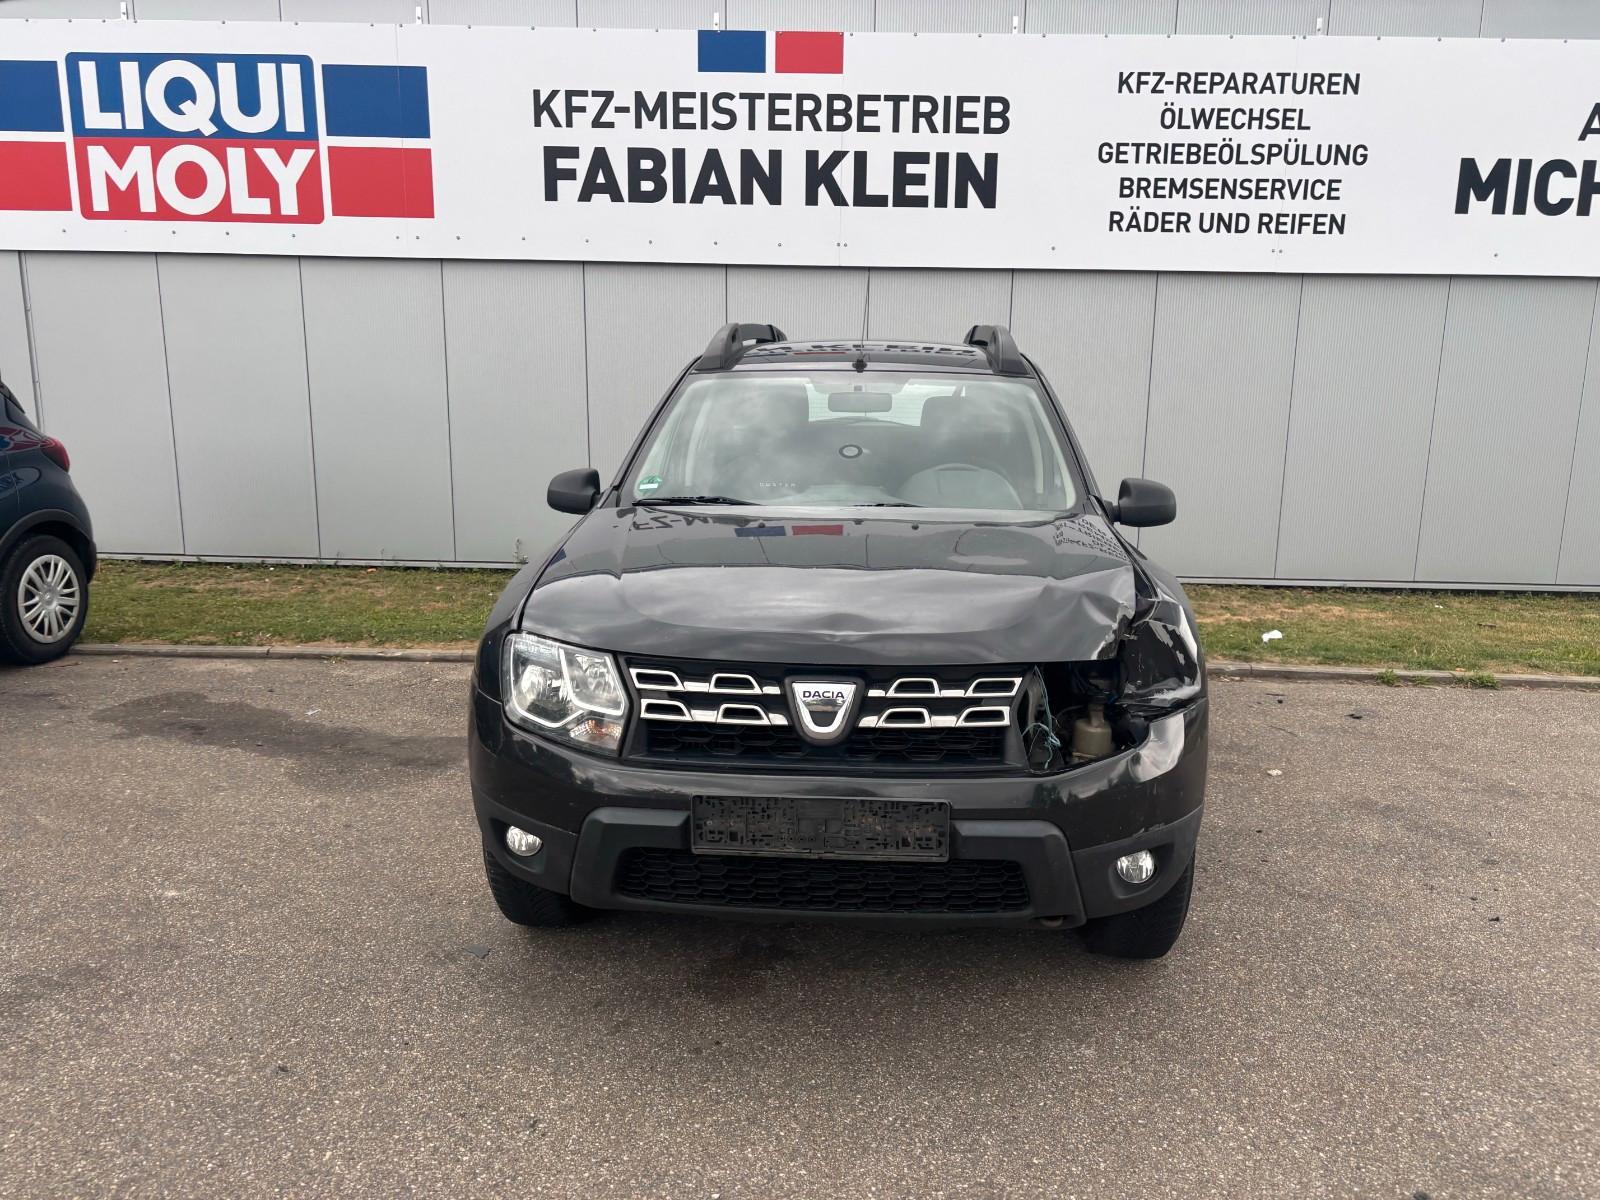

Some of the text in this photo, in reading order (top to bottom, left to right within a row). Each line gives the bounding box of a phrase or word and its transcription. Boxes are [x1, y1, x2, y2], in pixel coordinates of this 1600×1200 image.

[77, 59, 306, 137] LIQUI
[1118, 72, 1360, 95] KFZ-REPARATUREN
[532, 89, 1011, 135] KFZ-MEISTERBETRIEB
[1160, 101, 1311, 130] ÖLWECHSEL
[1098, 137, 1369, 166] GETRIEBEÖLSPÜLUNG
[86, 144, 317, 216] MOLY
[543, 146, 999, 209] FABIAN KLEIN
[1119, 177, 1343, 201] BREMSENSERVICE
[1108, 206, 1346, 235] RÄDER UND REIFEN
[802, 690, 845, 700] DACIA
